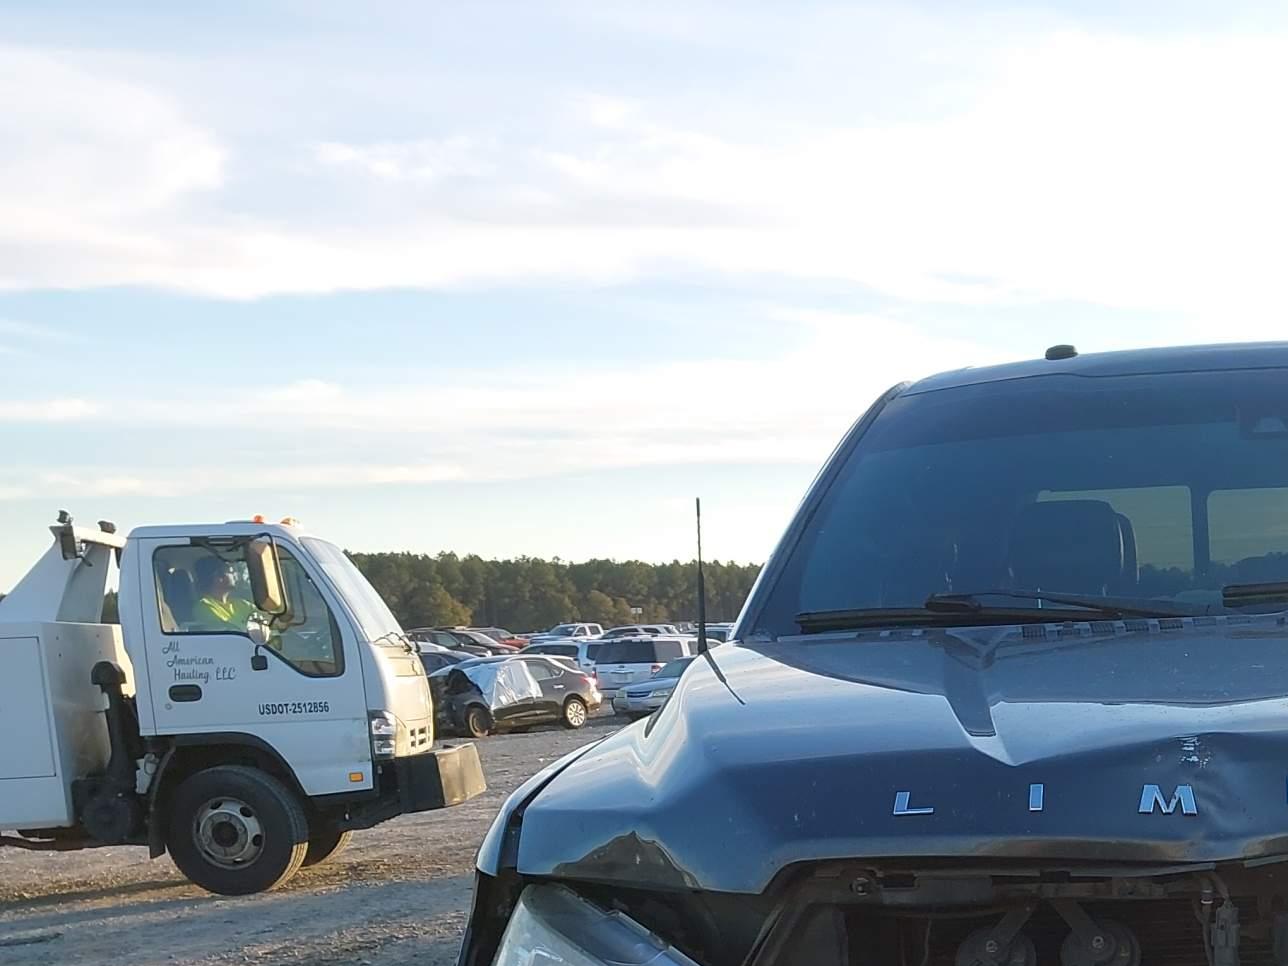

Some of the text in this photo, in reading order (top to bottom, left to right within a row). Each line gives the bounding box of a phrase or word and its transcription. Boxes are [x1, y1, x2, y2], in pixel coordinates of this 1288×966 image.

[162, 640, 180, 654] All
[167, 654, 214, 667] American
[216, 667, 236, 680] LLC
[258, 701, 330, 715] USDOT-2512856
